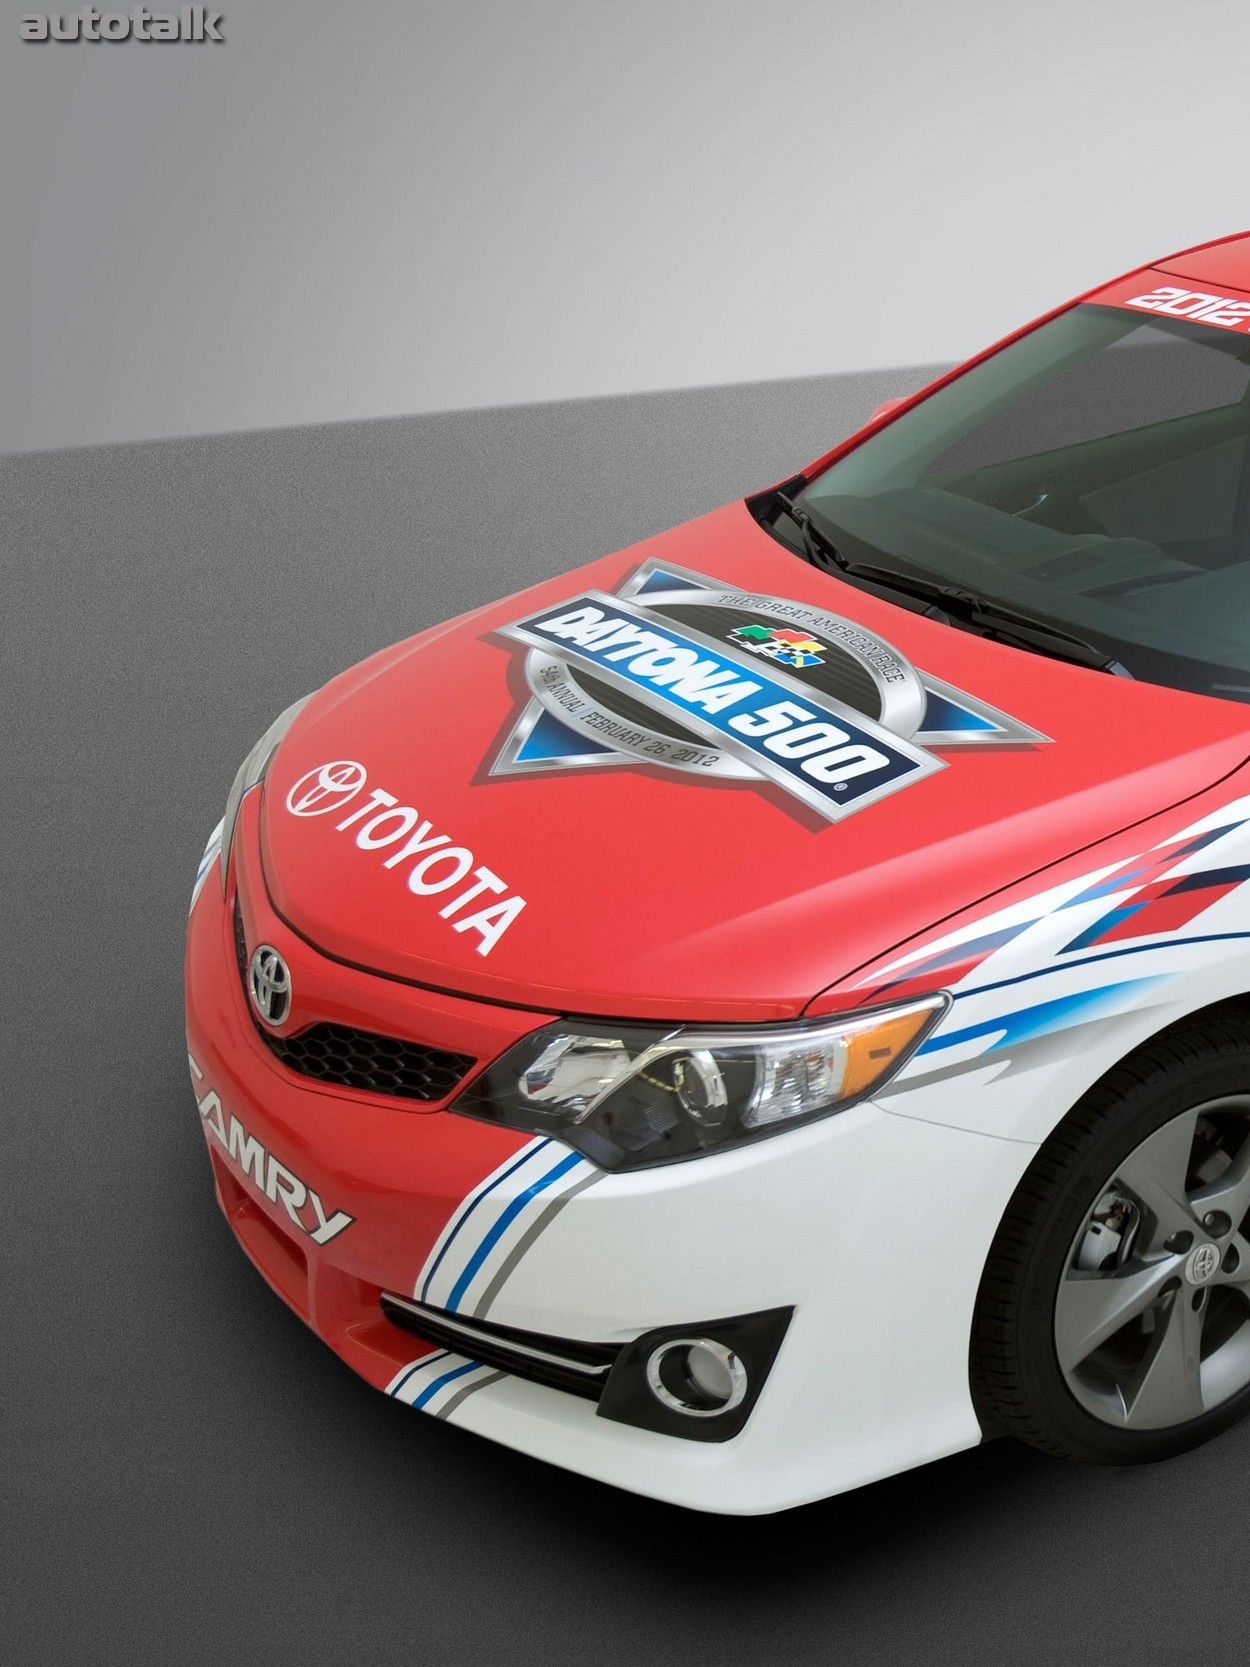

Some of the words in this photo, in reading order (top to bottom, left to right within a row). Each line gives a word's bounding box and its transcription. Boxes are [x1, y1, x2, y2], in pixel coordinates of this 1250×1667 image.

[719, 595, 755, 607] THE
[755, 600, 813, 619] GREAT
[808, 616, 881, 656] AMERICAN
[870, 651, 905, 683] RACE
[534, 606, 763, 716] DAYTONA
[540, 666, 559, 685] 54th
[549, 683, 587, 713] ANNUAL
[580, 712, 651, 746] FEBRUARY
[644, 741, 671, 758] 26,
[671, 749, 719, 767] 2012
[335, 788, 527, 957] TOYOTA
